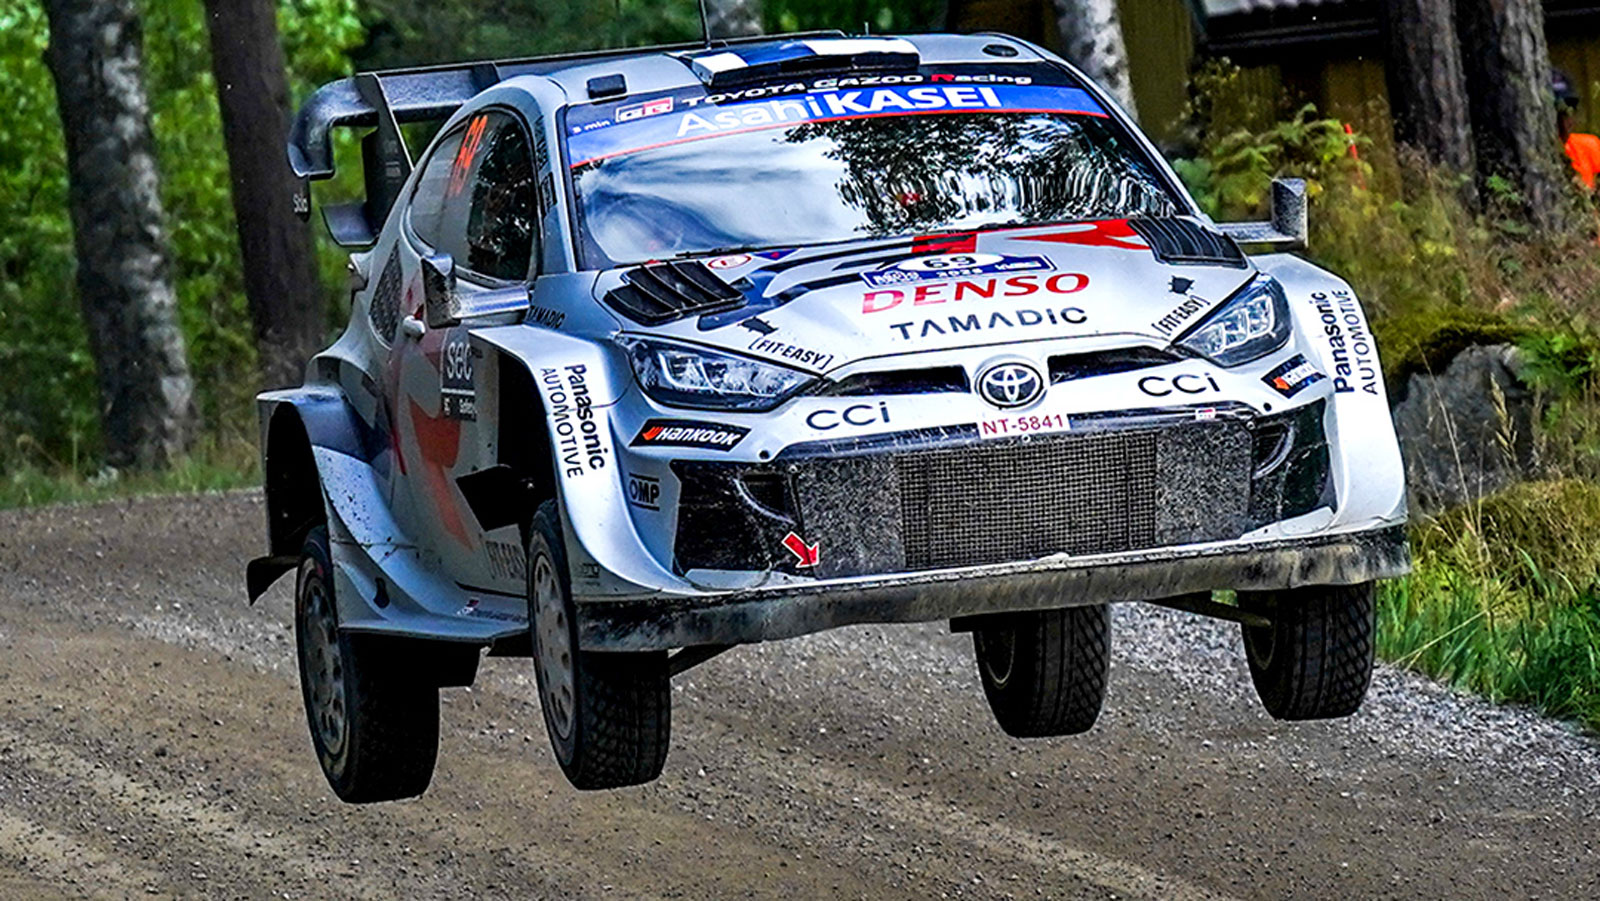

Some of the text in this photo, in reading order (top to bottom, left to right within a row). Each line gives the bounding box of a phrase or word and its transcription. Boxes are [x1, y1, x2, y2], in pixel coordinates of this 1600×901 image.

[682, 82, 806, 107] TOYOTA
[813, 75, 924, 89] GAZOO
[923, 255, 977, 269] 69
[862, 273, 1090, 314] DENSO
[889, 307, 1088, 340] TAMADIC
[1309, 291, 1355, 394] Panasonic
[1332, 290, 1379, 395] AUTOMOTIVE
[540, 368, 584, 478] AUTOMOTIVE
[564, 364, 608, 470] Panasonic
[982, 414, 1064, 435] NT-5841
[629, 478, 660, 504] OMP
